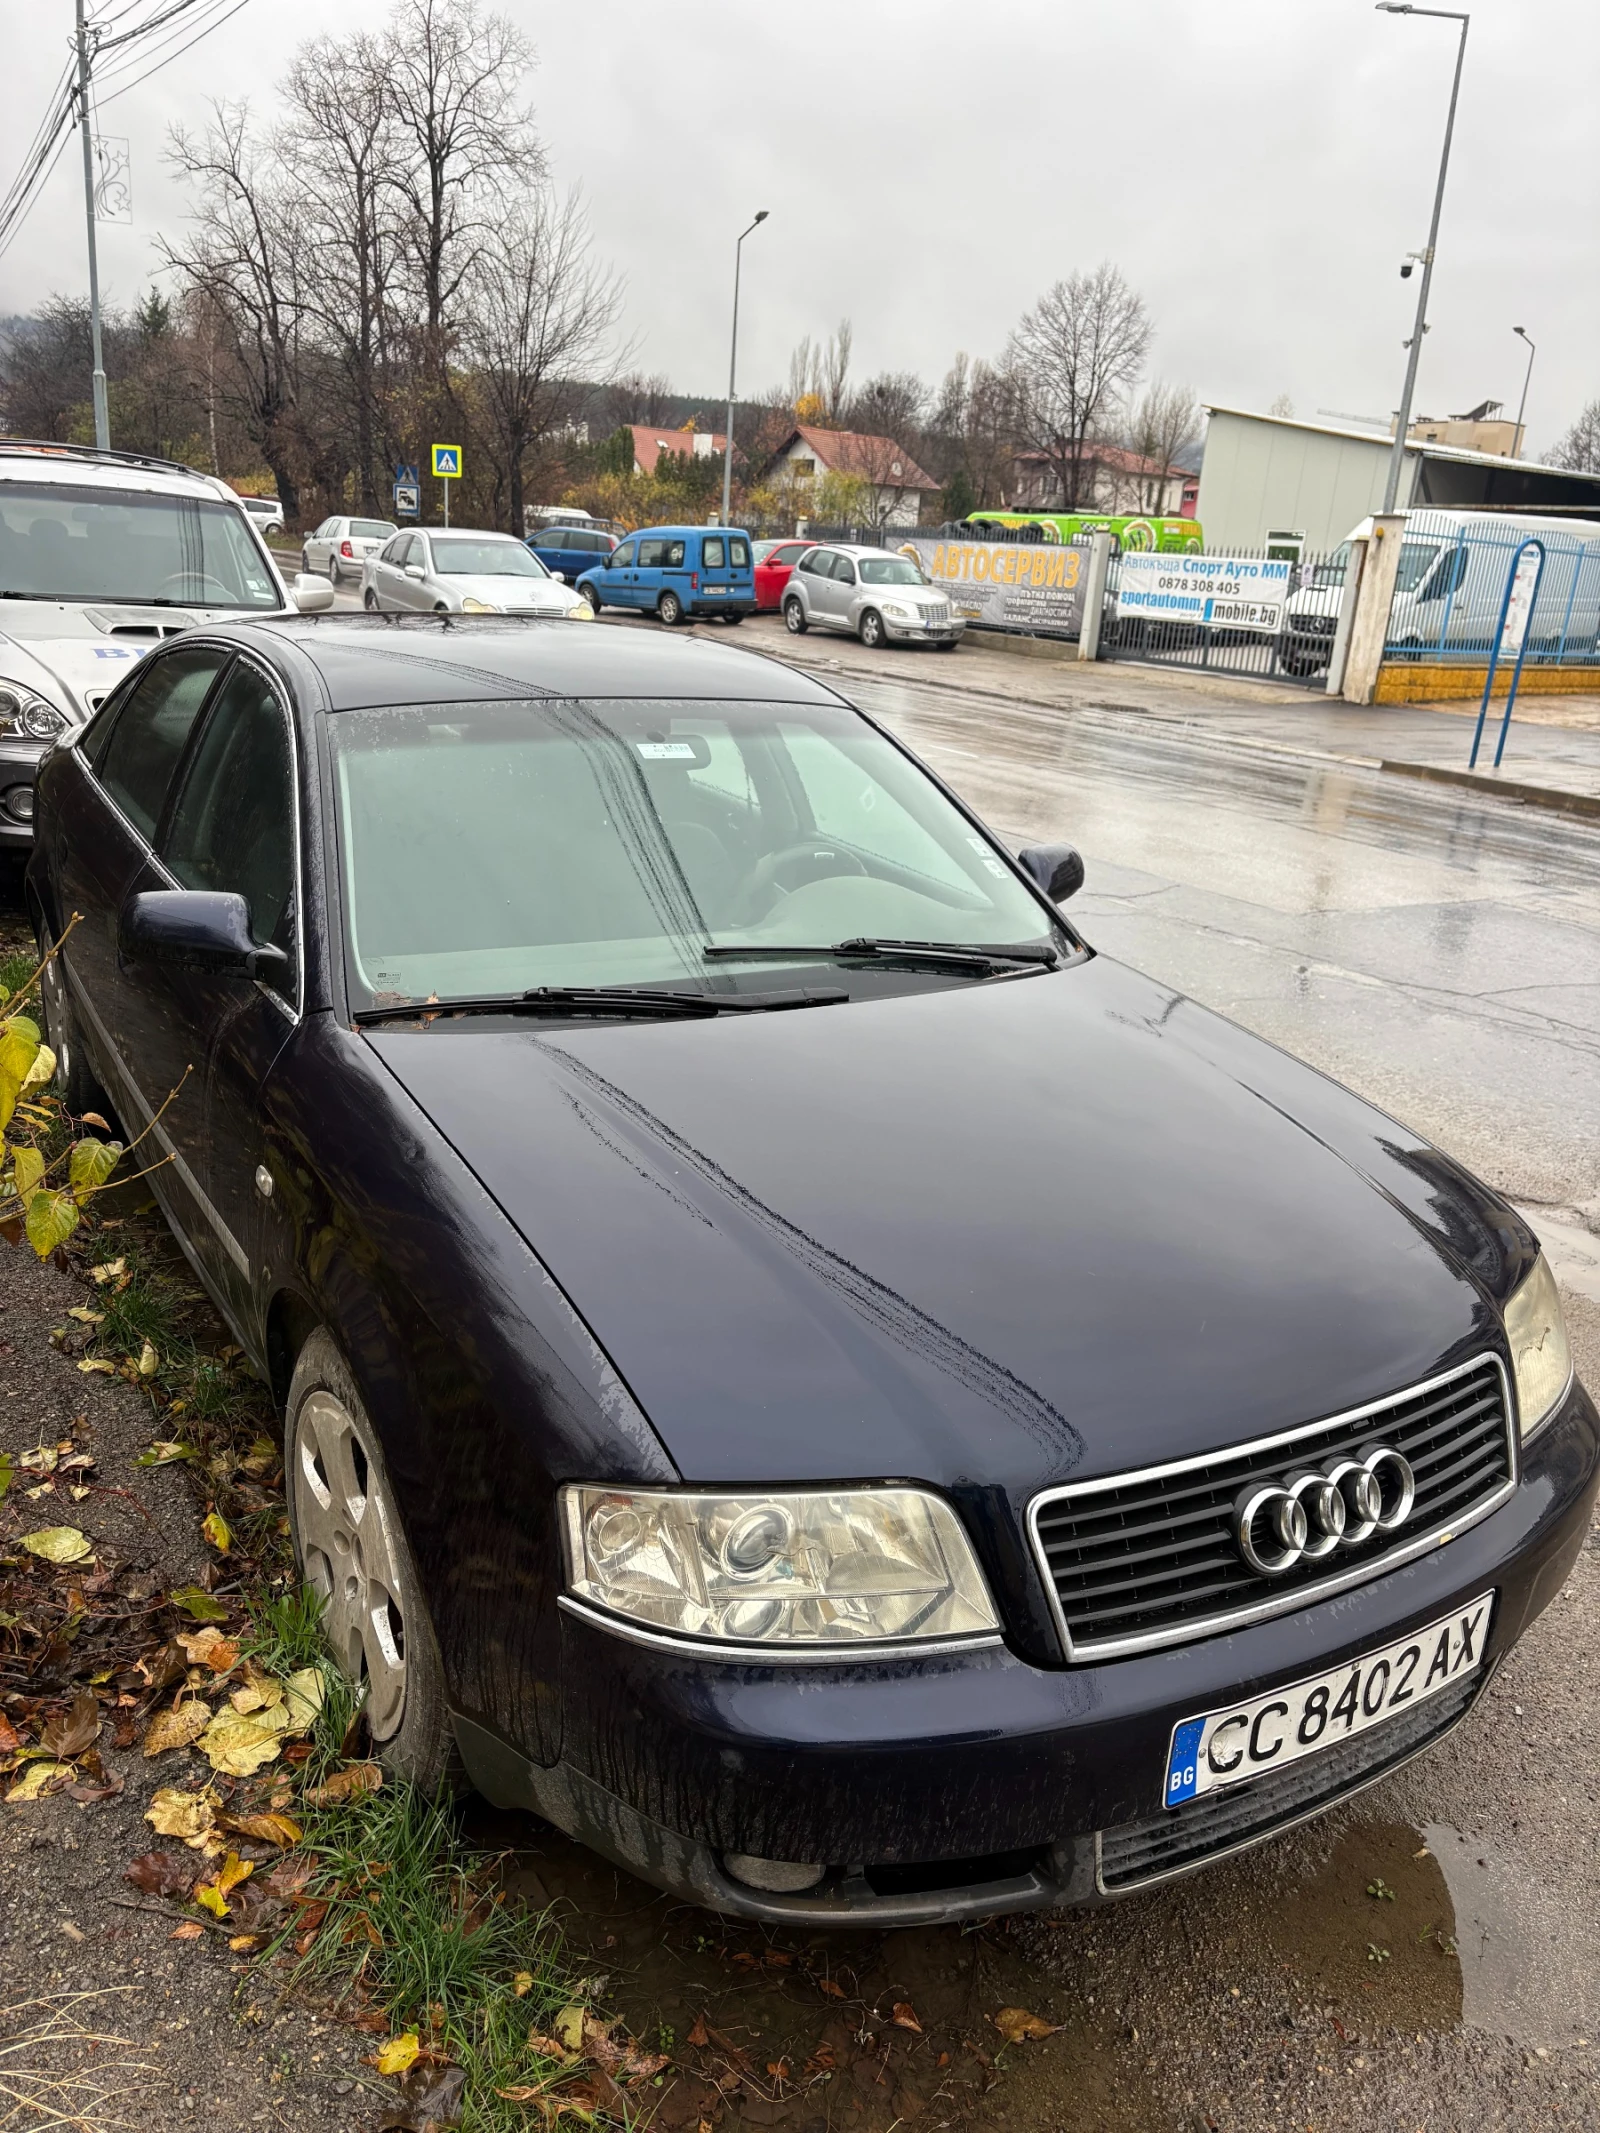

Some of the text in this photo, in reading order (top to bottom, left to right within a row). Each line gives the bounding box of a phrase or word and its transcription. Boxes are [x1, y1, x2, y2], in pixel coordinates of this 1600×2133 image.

[931, 544, 1080, 589] АВТОСЕРВИЗ
[1125, 555, 1180, 573] Автокъща
[1183, 558, 1222, 578] Спорт
[1225, 561, 1258, 580] Ауто
[1158, 577, 1240, 595] 0878 308 405
[1214, 602, 1276, 627] mobile.bg
[1208, 1606, 1484, 1774] CC 8402 AX
[1170, 1766, 1194, 1792] BG
